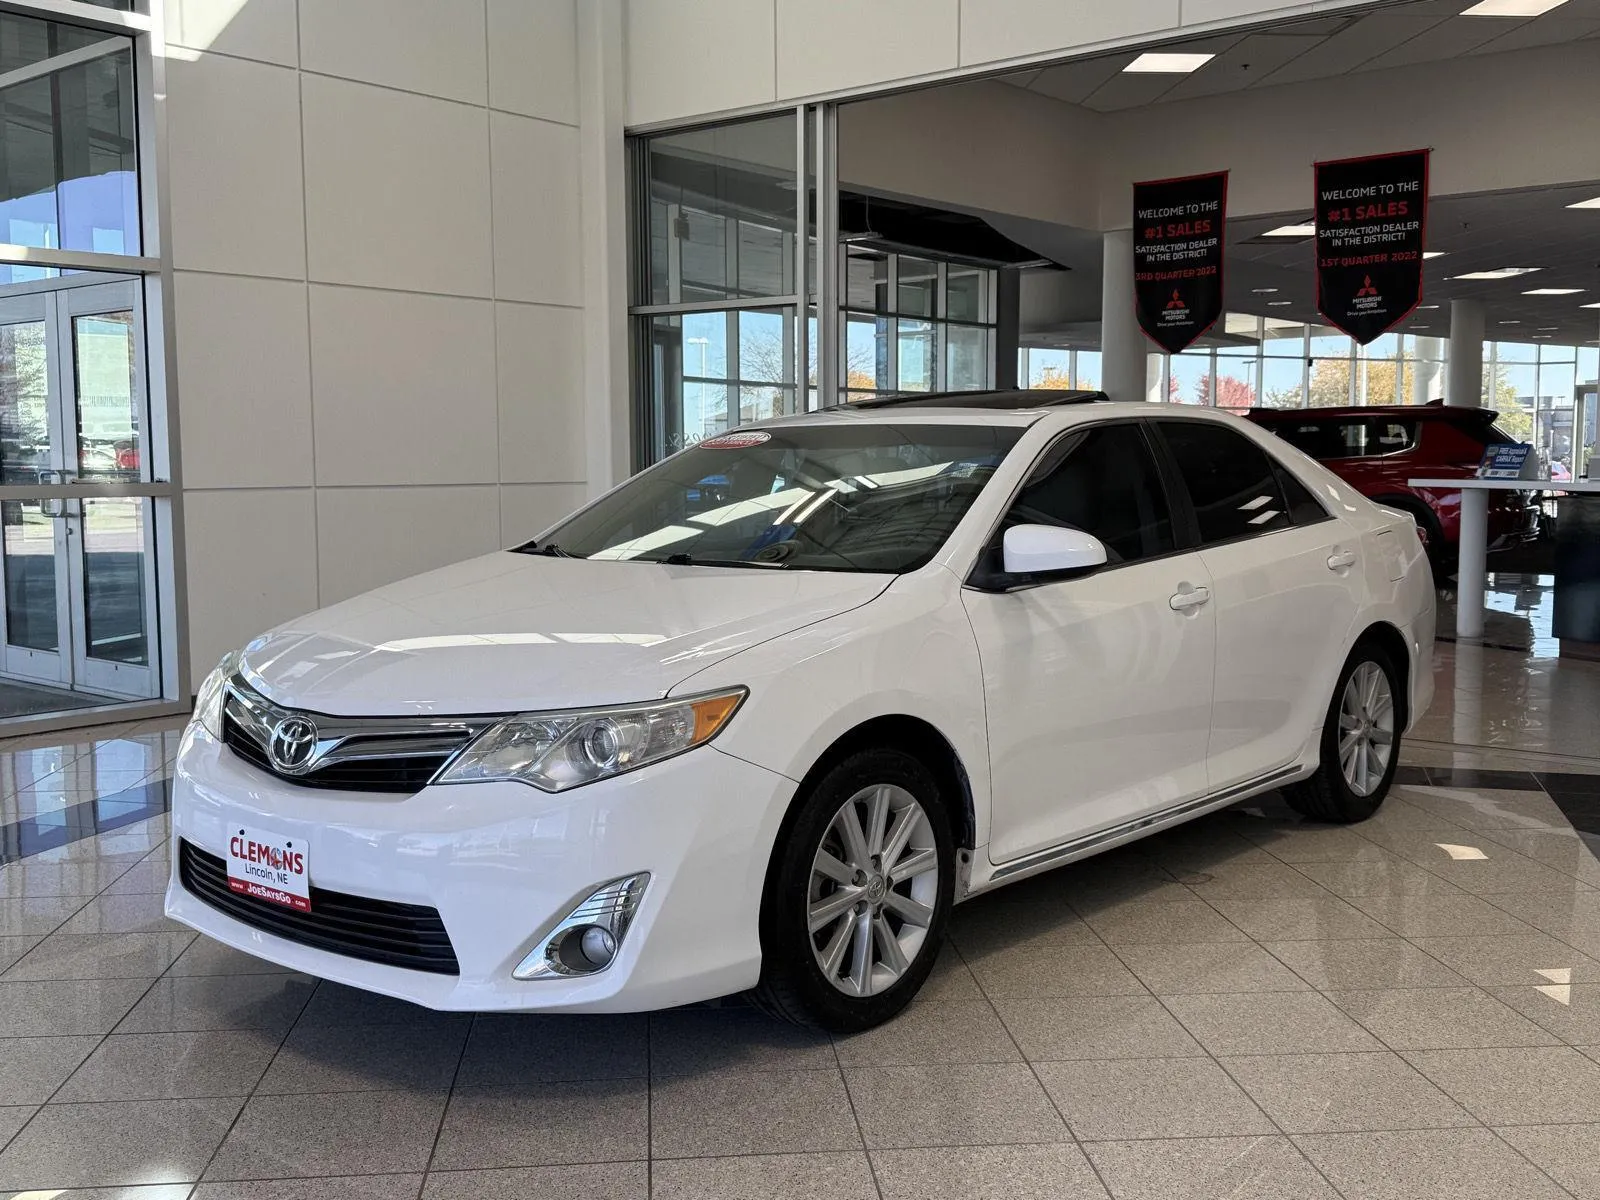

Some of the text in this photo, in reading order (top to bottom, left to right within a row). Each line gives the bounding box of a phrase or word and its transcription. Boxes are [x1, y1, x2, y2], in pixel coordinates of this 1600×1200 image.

[1322, 181, 1419, 201] WELCOME TO THE
[1138, 200, 1218, 219] WELCOME TO THE
[1328, 201, 1408, 221] #1 SALES
[1144, 220, 1211, 239] #1 SALES
[1319, 221, 1419, 238] SATISFACTION DEALER
[1135, 238, 1218, 254] SATISFACTION DEALER
[1332, 232, 1406, 247] IN THE DISTRICT!
[1146, 248, 1207, 262] IN THE DISTRICT!
[1321, 258, 1338, 267] 1ST
[1341, 254, 1388, 267] QUARTER
[1154, 269, 1195, 281] QUARTER
[230, 836, 304, 875] CLEMONS
[245, 863, 289, 885] Lincoln, NE
